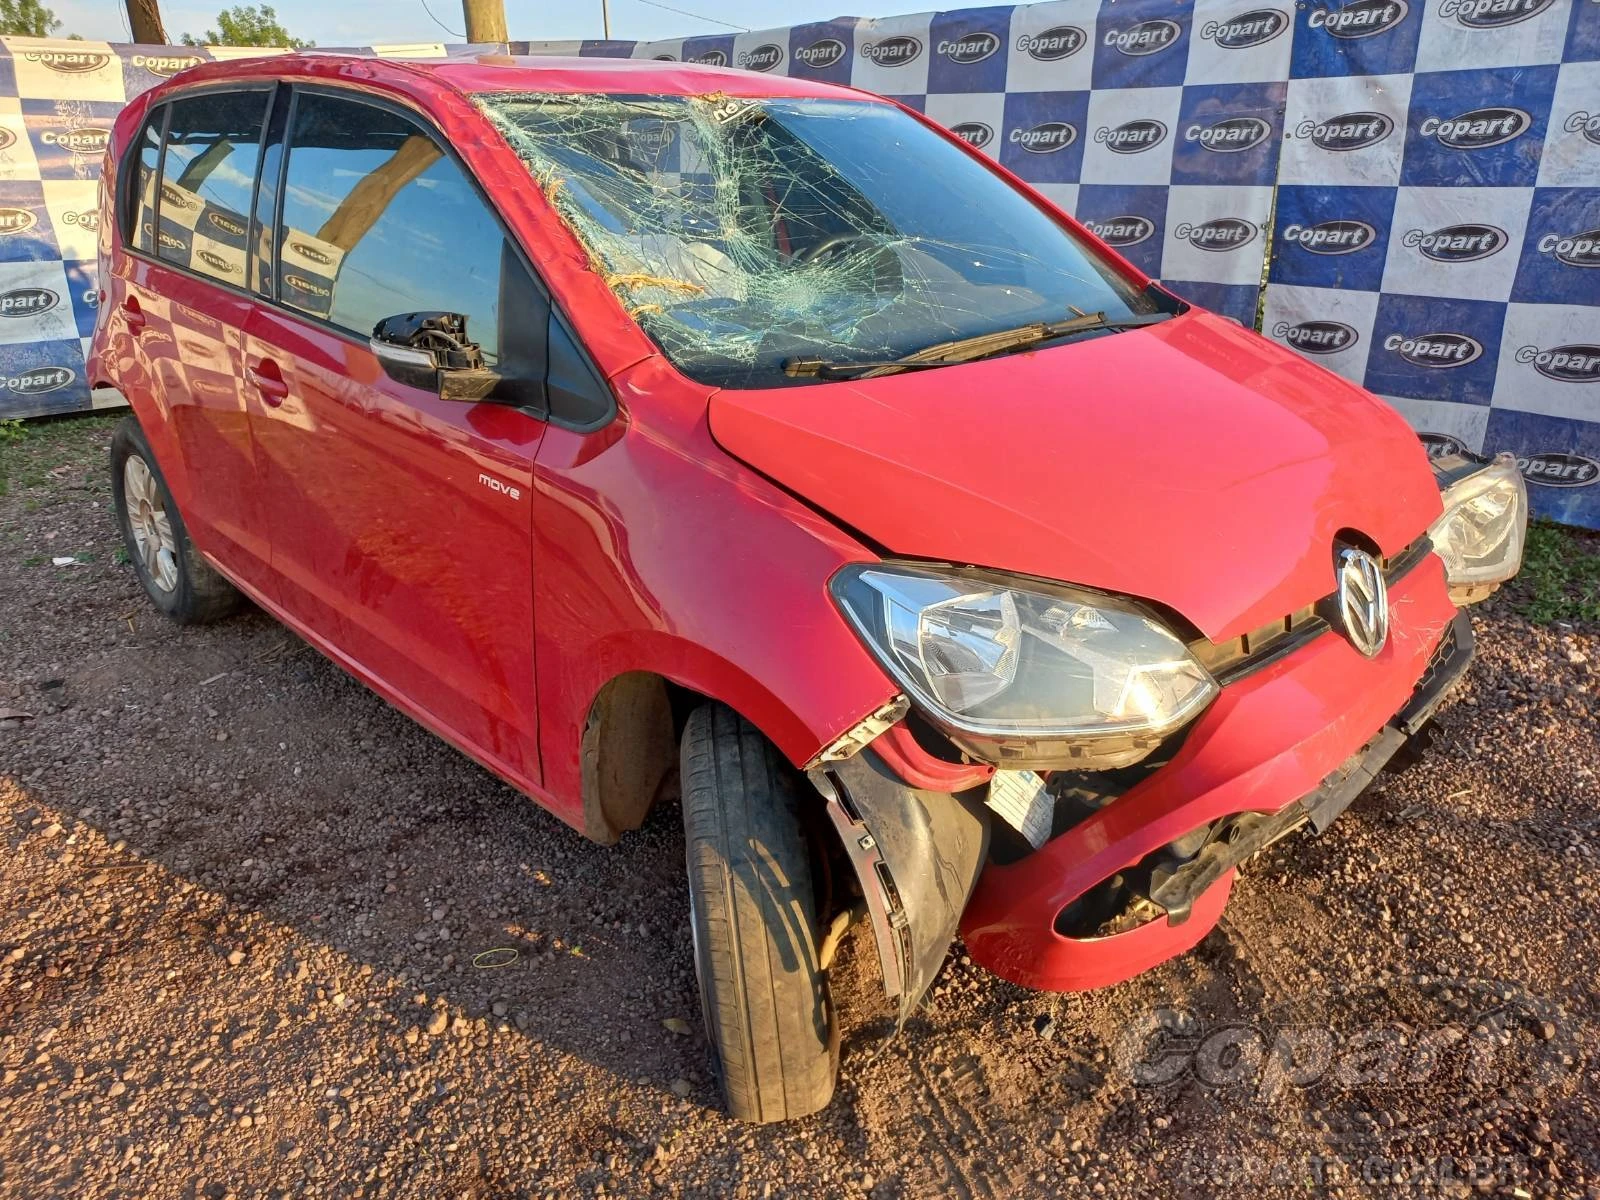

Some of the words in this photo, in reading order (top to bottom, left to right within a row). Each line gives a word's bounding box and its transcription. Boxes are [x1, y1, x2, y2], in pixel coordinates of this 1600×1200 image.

[1200, 15, 1275, 41] Copart
[1308, 5, 1396, 31] Copart
[937, 38, 992, 56] Copart
[1017, 33, 1078, 55] Copart
[1104, 25, 1172, 50] Copart
[132, 56, 199, 71] Copart
[738, 49, 776, 69] Copart
[794, 43, 838, 62] Copart
[861, 42, 915, 63] Copart
[1094, 126, 1157, 148] Copart
[1185, 124, 1260, 145] Copart
[1296, 120, 1384, 140] Copart
[1419, 113, 1518, 139] Copart
[1009, 127, 1069, 148] Copart
[62, 211, 98, 228] Cop
[1175, 222, 1248, 244] Copart
[1284, 224, 1363, 246] Copart
[1402, 228, 1497, 254] Copart
[1538, 233, 1600, 258] Cop
[1, 293, 46, 311] part
[1272, 321, 1347, 344] Copart
[1384, 335, 1470, 359] Copart
[1515, 345, 1600, 370] Copar
[1517, 457, 1592, 480] opart
[479, 473, 520, 500] move
